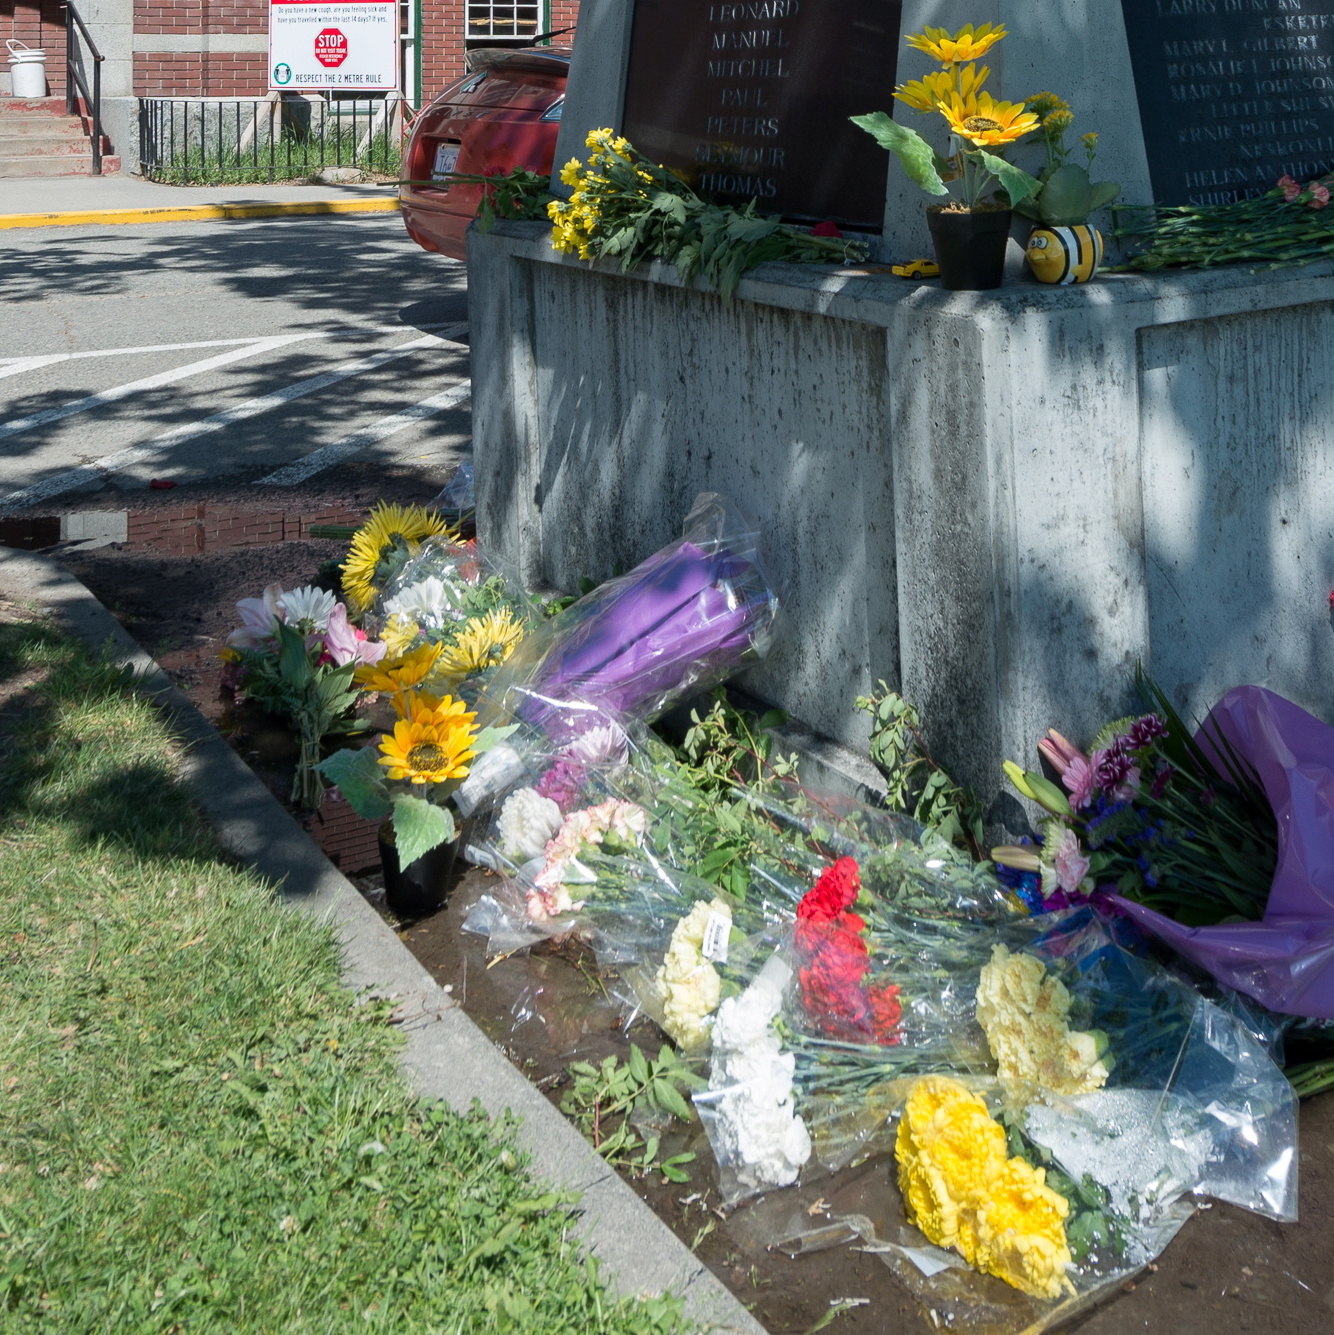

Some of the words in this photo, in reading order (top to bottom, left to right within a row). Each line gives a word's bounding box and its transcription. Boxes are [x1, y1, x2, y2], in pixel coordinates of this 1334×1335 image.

[285, 7, 293, 15] you
[351, 5, 367, 14] feeling
[367, 5, 377, 13] sick
[378, 5, 387, 13] and
[318, 15, 332, 23] within
[358, 15, 371, 23] days?
[318, 35, 344, 47] STOP
[711, 28, 790, 51] MANUEL
[707, 58, 790, 78] MITCHEL
[295, 74, 322, 83] RESPECT
[325, 74, 335, 83] THE
[338, 74, 342, 83] 2
[344, 74, 362, 83] METRE
[366, 74, 382, 83] RULE
[721, 87, 768, 107] PAUL
[707, 116, 780, 138] PETERS
[695, 143, 786, 168] SEYMOUR
[699, 173, 778, 197] THOMAS
